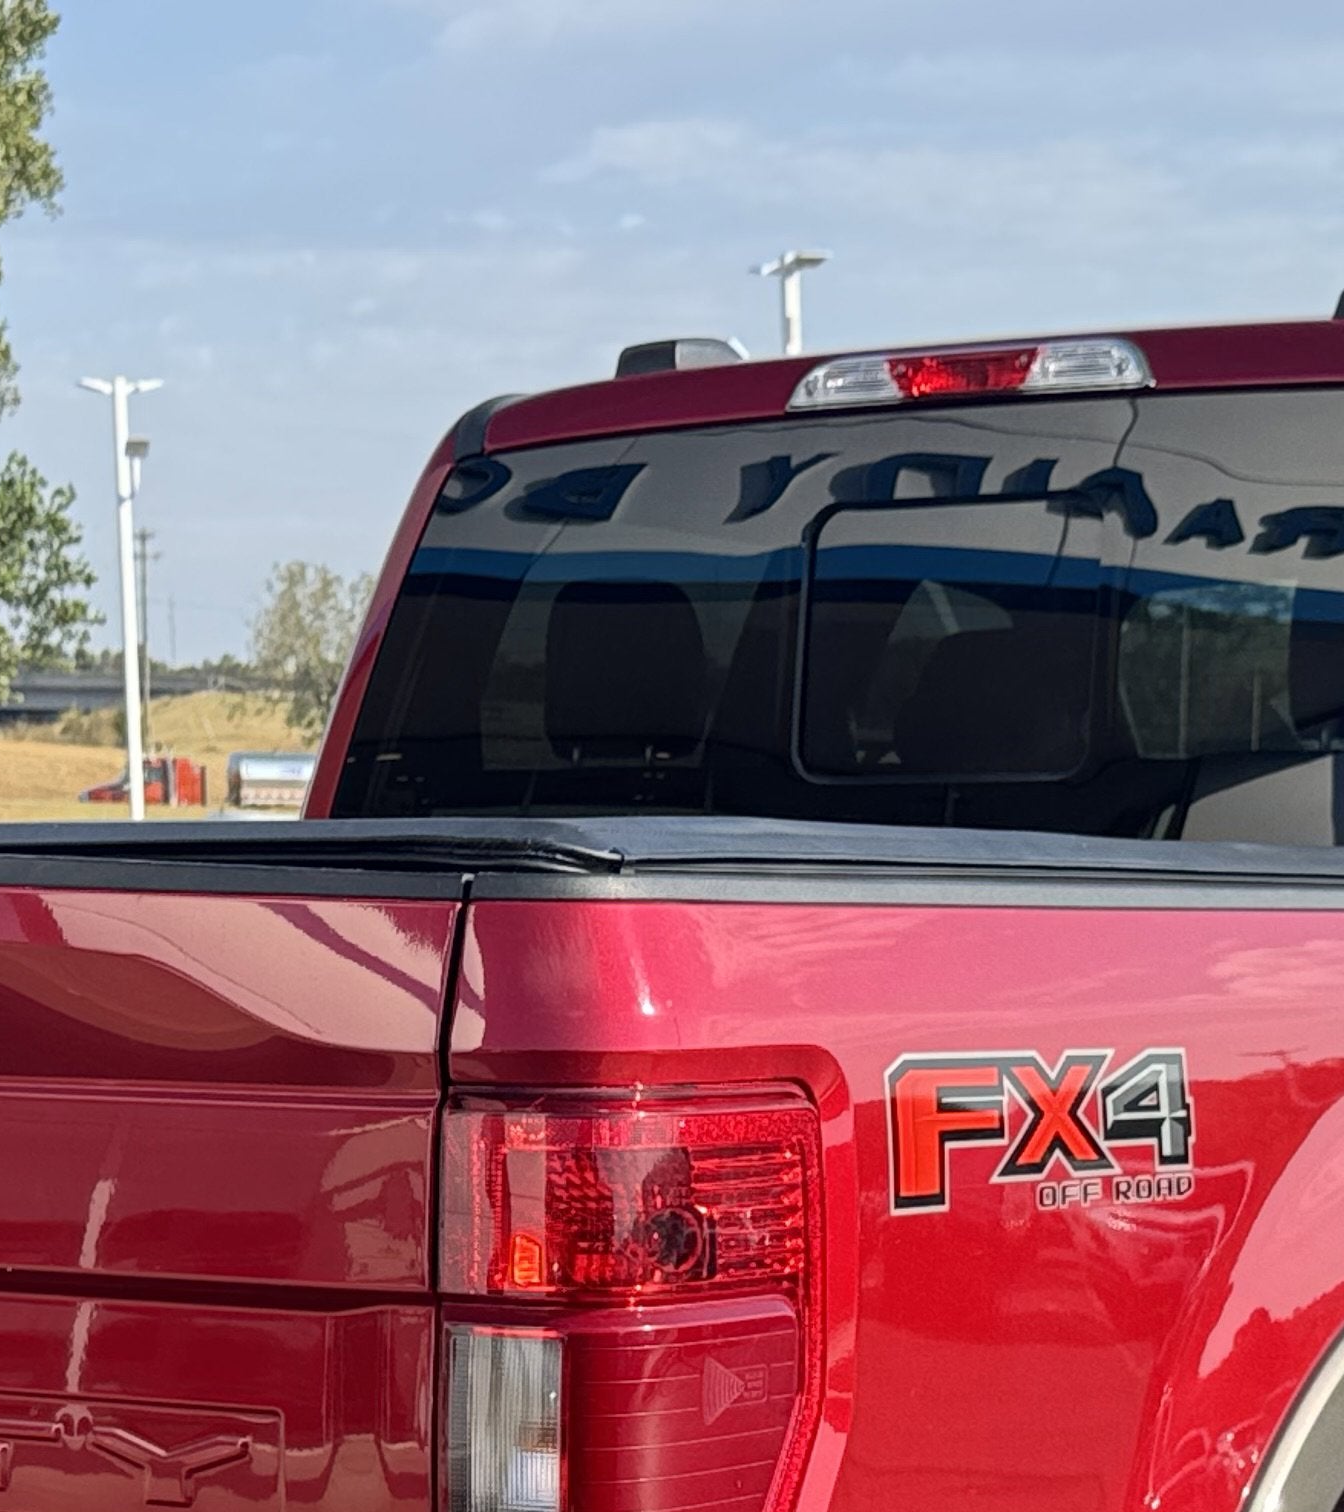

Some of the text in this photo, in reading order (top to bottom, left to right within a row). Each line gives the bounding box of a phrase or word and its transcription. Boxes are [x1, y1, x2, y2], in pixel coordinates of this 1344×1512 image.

[884, 1047, 1196, 1216] FX4
[1037, 1174, 1193, 1209] OFF ROAD
